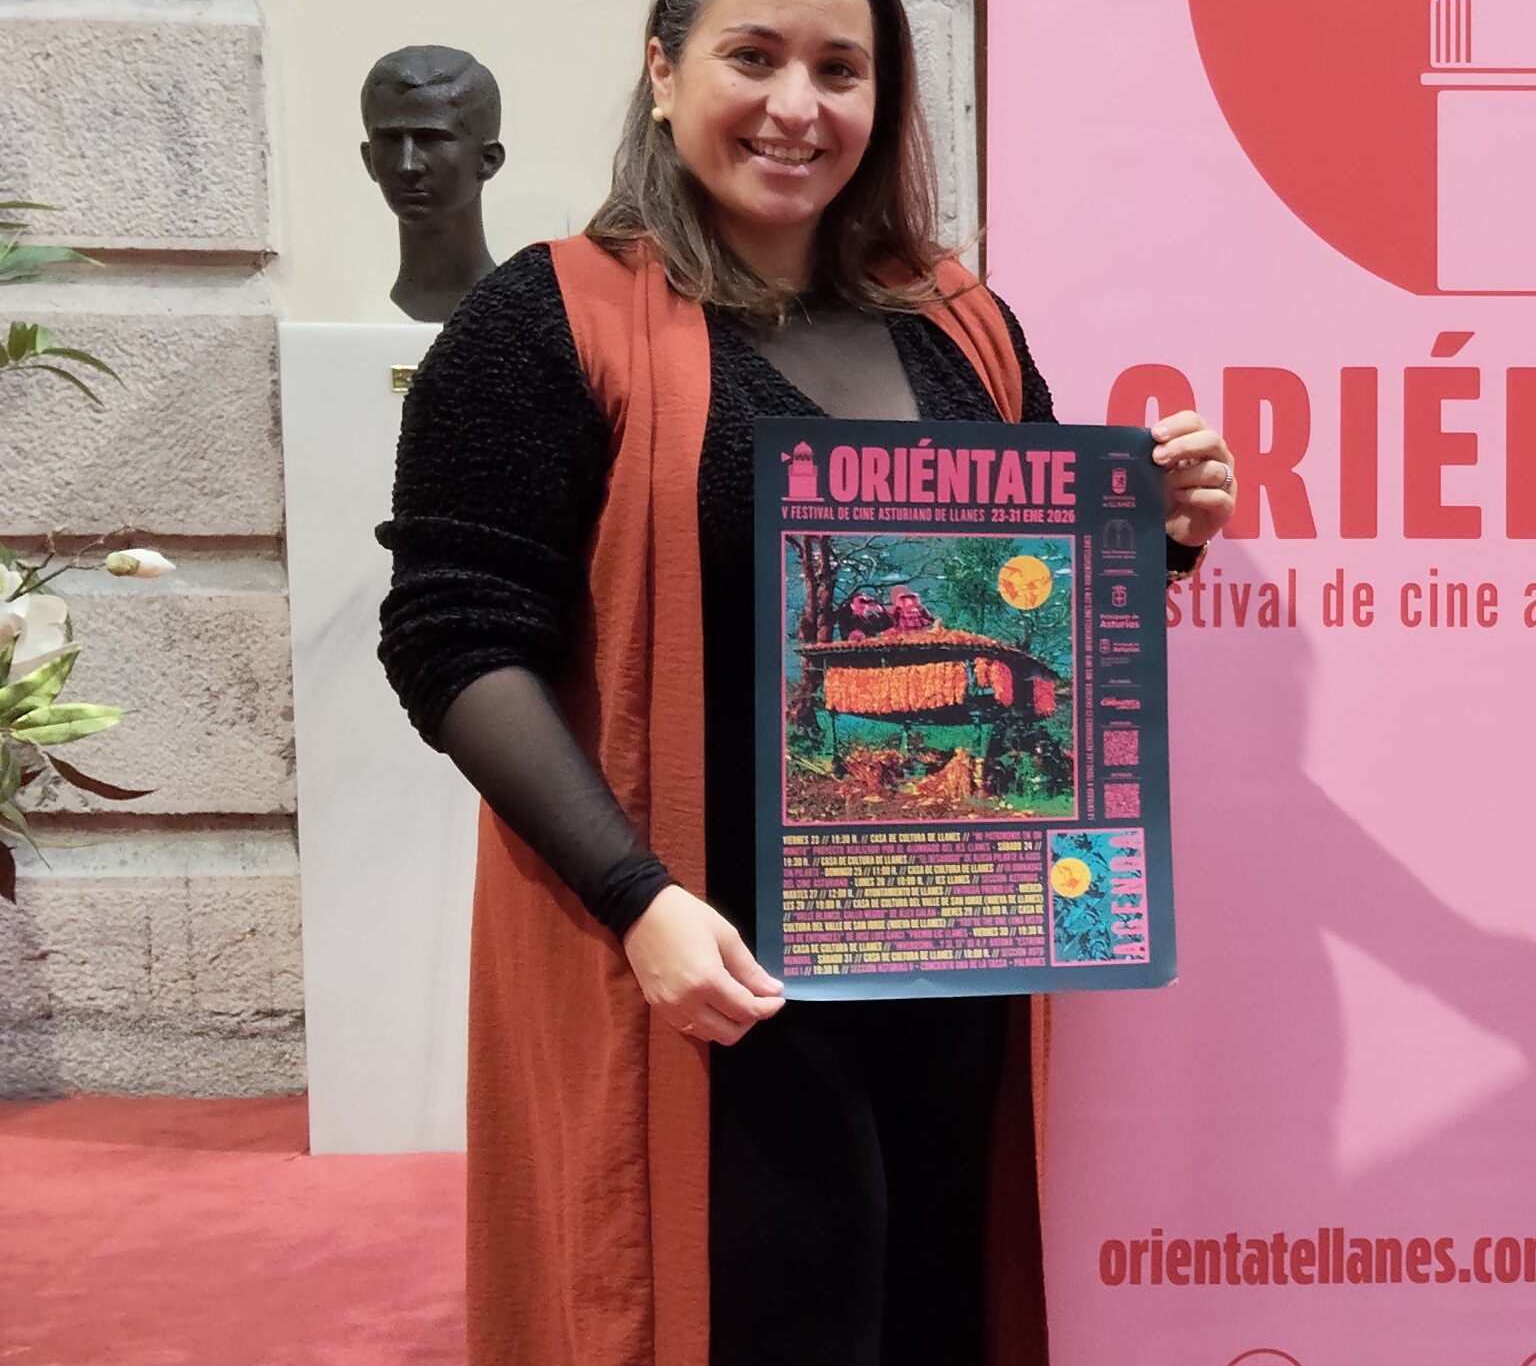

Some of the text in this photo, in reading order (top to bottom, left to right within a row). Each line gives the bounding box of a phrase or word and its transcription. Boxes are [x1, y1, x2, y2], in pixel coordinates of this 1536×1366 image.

[829, 438, 1076, 505] ORIÉNTATE
[791, 506, 834, 520] FESTIVAL
[838, 507, 849, 519] DE
[853, 507, 874, 520] CINE
[878, 507, 932, 521] ASTURIANO
[935, 508, 947, 521] DE
[950, 509, 985, 522] LLANES
[991, 509, 1020, 523] 23-31
[1023, 509, 1044, 523] ENE
[1047, 510, 1076, 524] 2026
[1166, 568, 1297, 629] stival
[1323, 569, 1376, 629] de
[1400, 569, 1499, 629] cine
